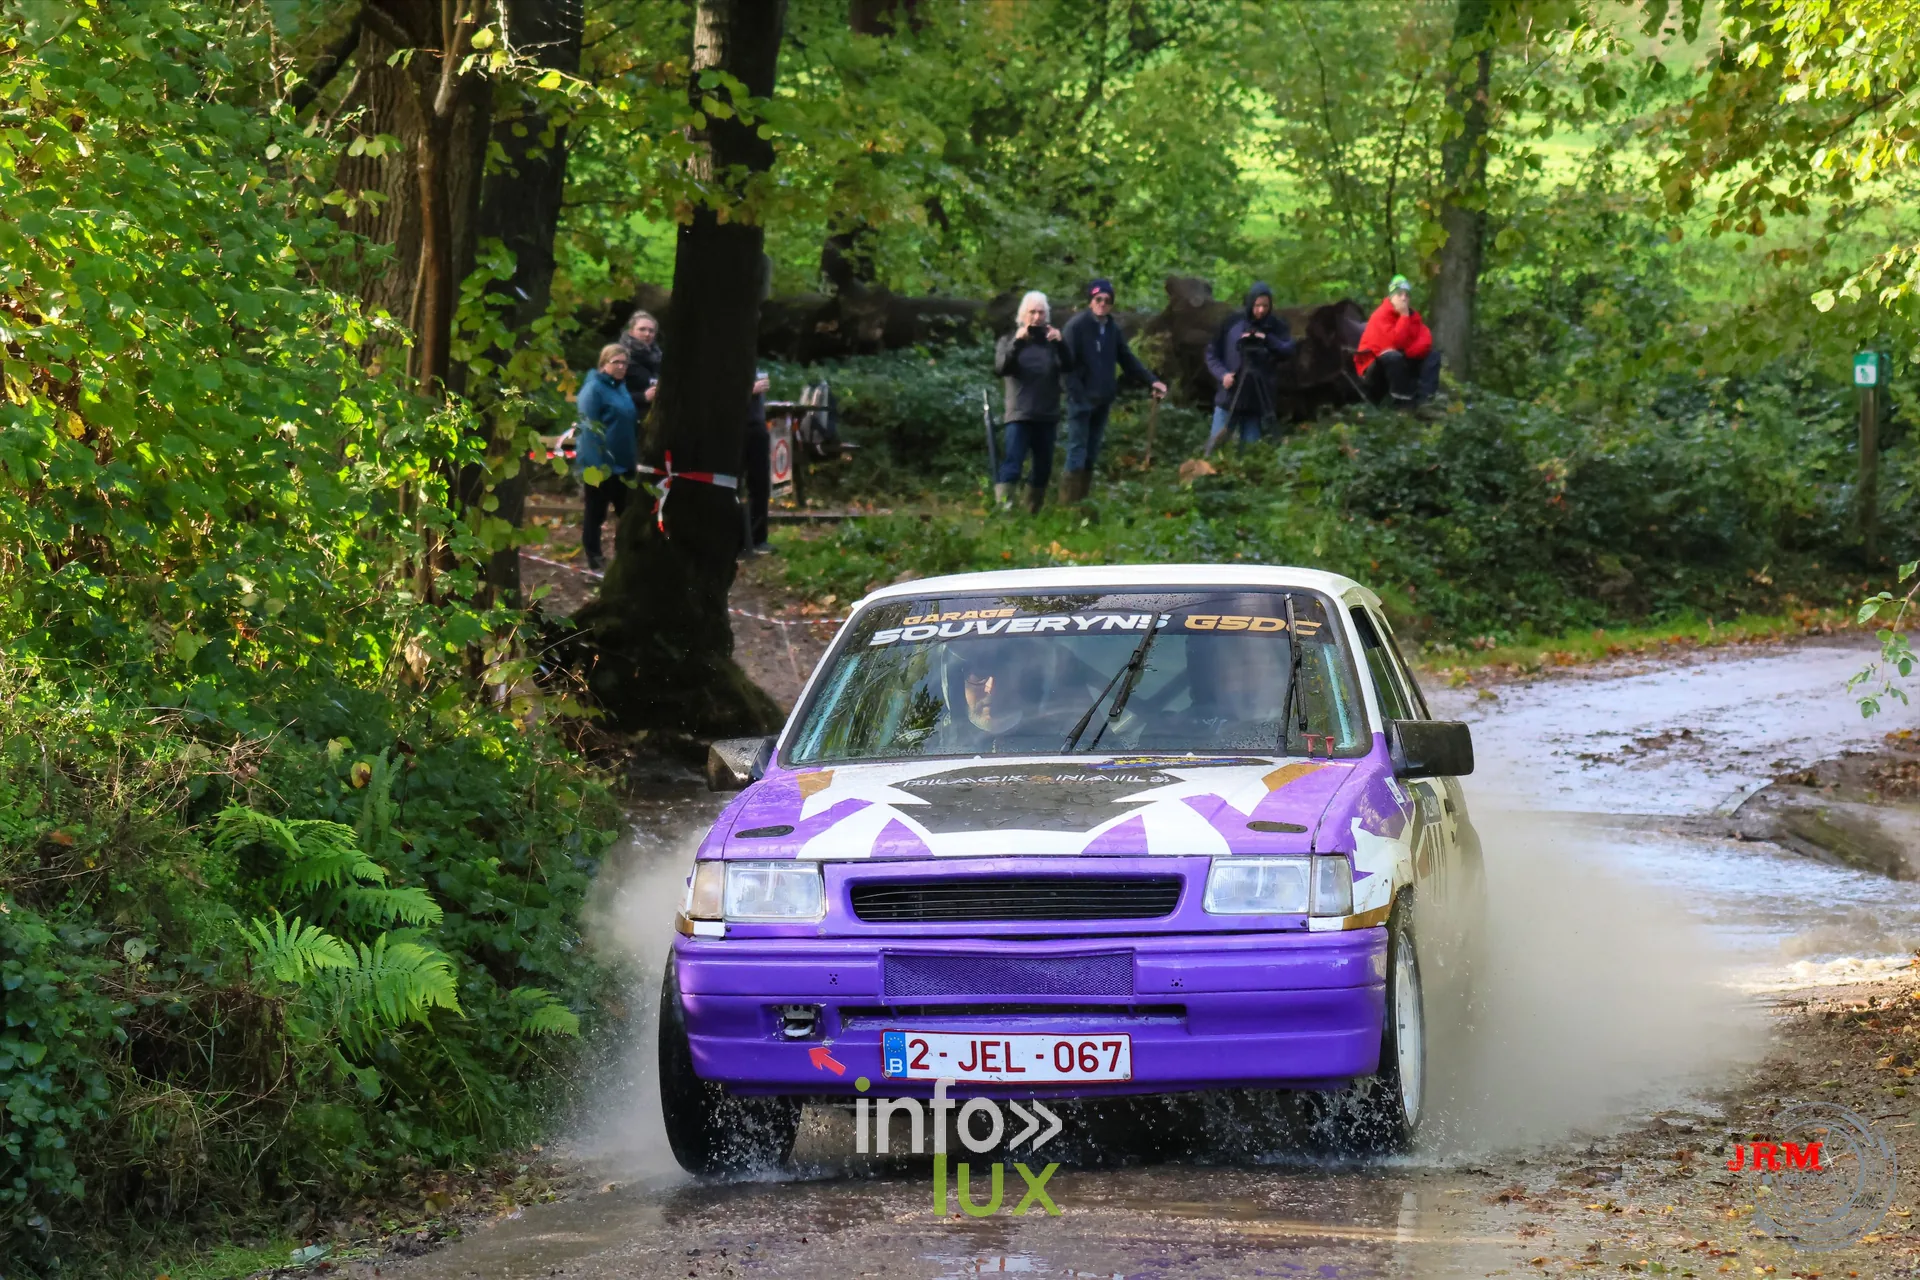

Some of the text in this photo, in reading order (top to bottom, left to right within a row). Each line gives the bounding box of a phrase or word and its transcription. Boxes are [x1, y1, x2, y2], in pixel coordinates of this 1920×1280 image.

[903, 608, 1017, 625] GARAGE
[868, 614, 1172, 646] SOUVERYNS
[889, 1058, 903, 1073] B
